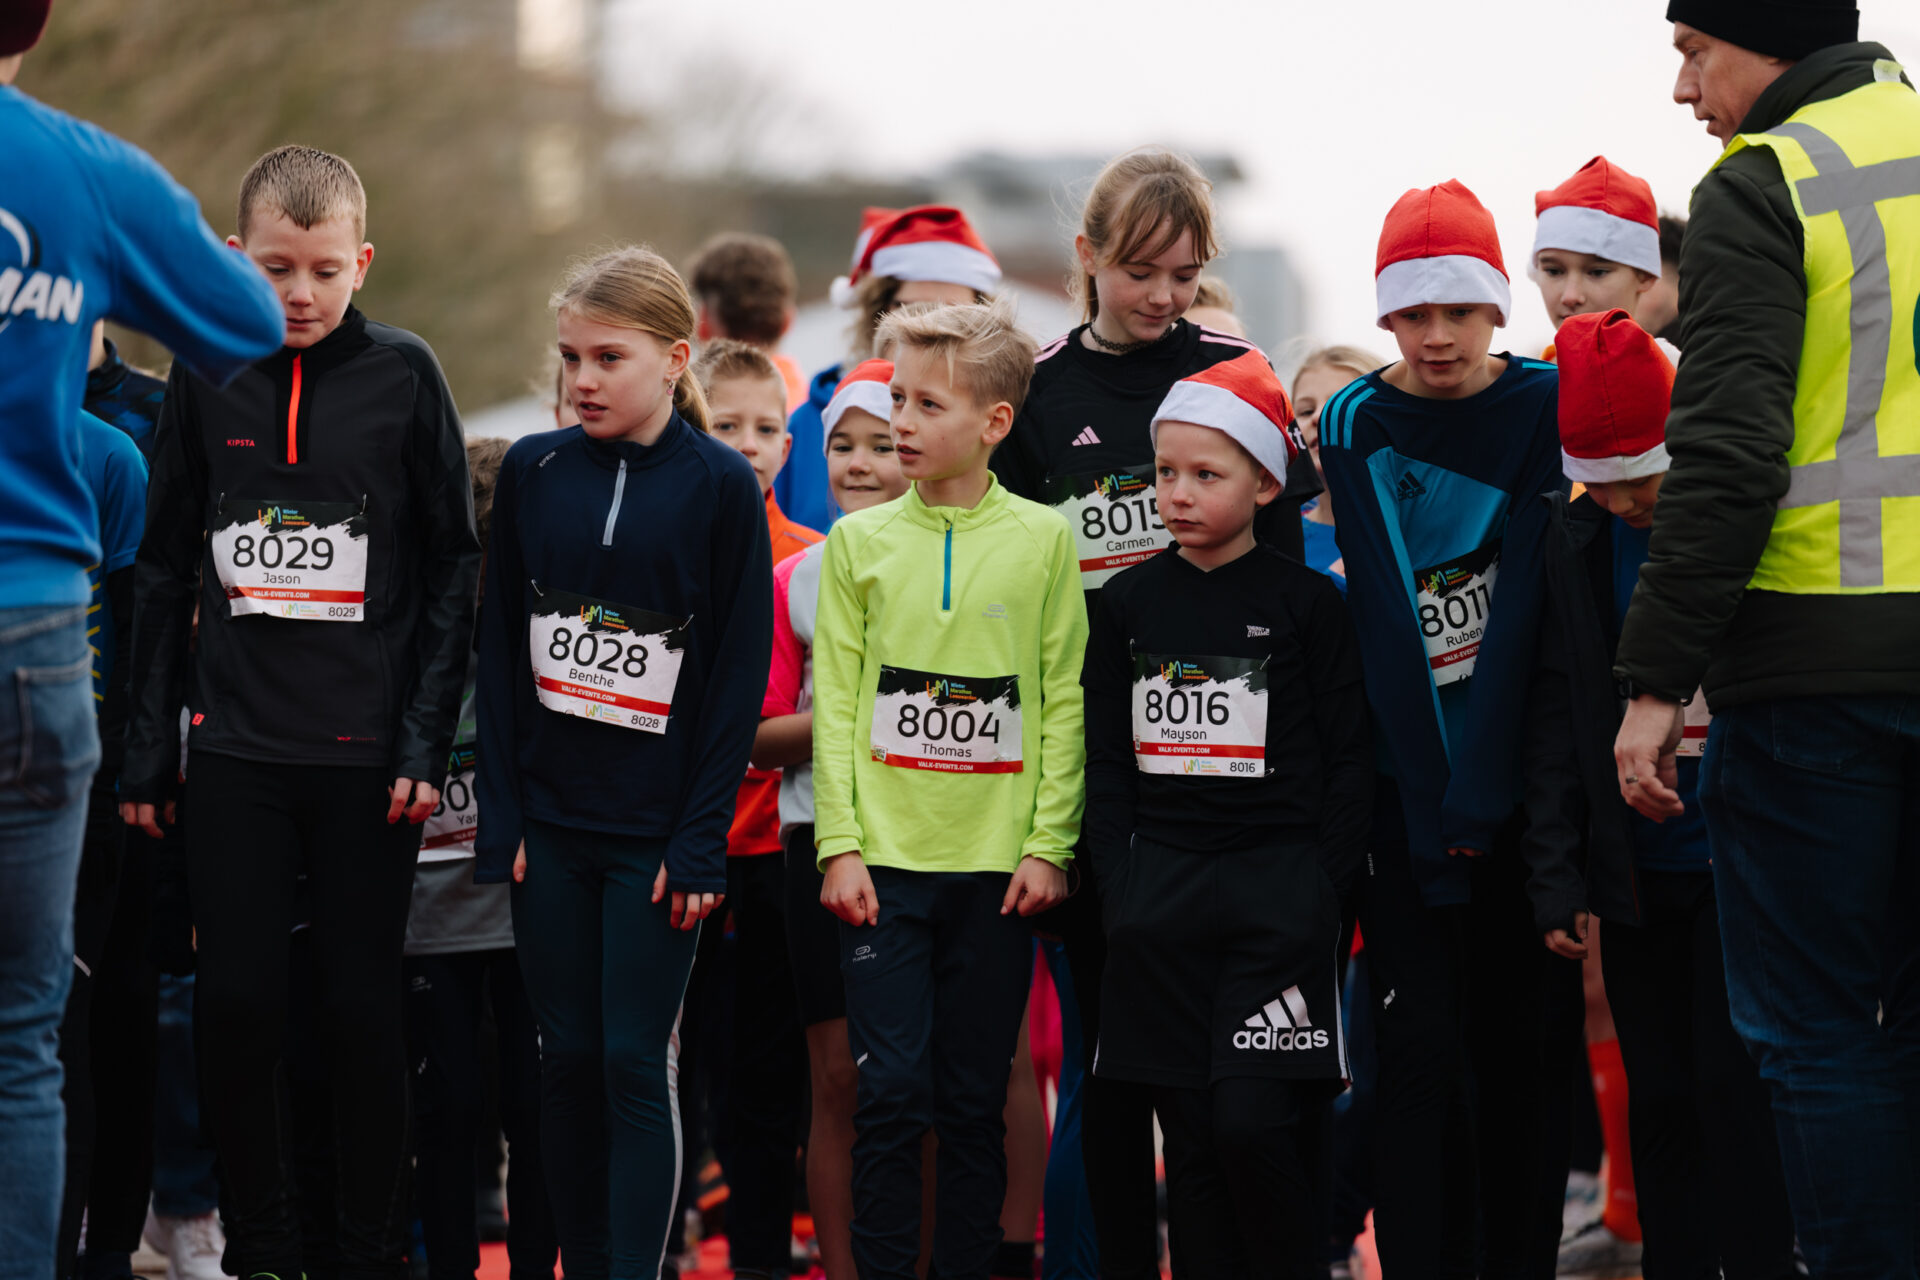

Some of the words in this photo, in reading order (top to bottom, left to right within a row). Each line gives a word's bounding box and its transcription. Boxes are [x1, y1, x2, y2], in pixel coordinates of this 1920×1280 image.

[227, 439, 255, 447] KIPSTA
[1081, 497, 1167, 540] 8015
[233, 534, 334, 570] 8029
[1106, 537, 1155, 552] Carmen
[263, 573, 301, 585] Jason
[253, 589, 310, 599] VALK-EVENTS.COM
[328, 606, 356, 618] 8029
[1418, 583, 1491, 637] 8011
[1445, 626, 1483, 648] Ruben
[548, 627, 649, 678] 8028
[568, 668, 615, 688] Benthe
[561, 684, 617, 703] VALK-EVENTS.COM
[1145, 689, 1230, 726] 8016
[630, 714, 660, 729] 8028
[897, 703, 1000, 744] 8004
[1160, 727, 1207, 742] Mayson
[921, 743, 972, 758] Thomas
[1158, 745, 1211, 754] VALK-EVENTS.COM
[917, 760, 974, 771] VALK-EVENTS.COM
[1229, 761, 1256, 773] 8016
[1232, 1026, 1329, 1051] adidas
